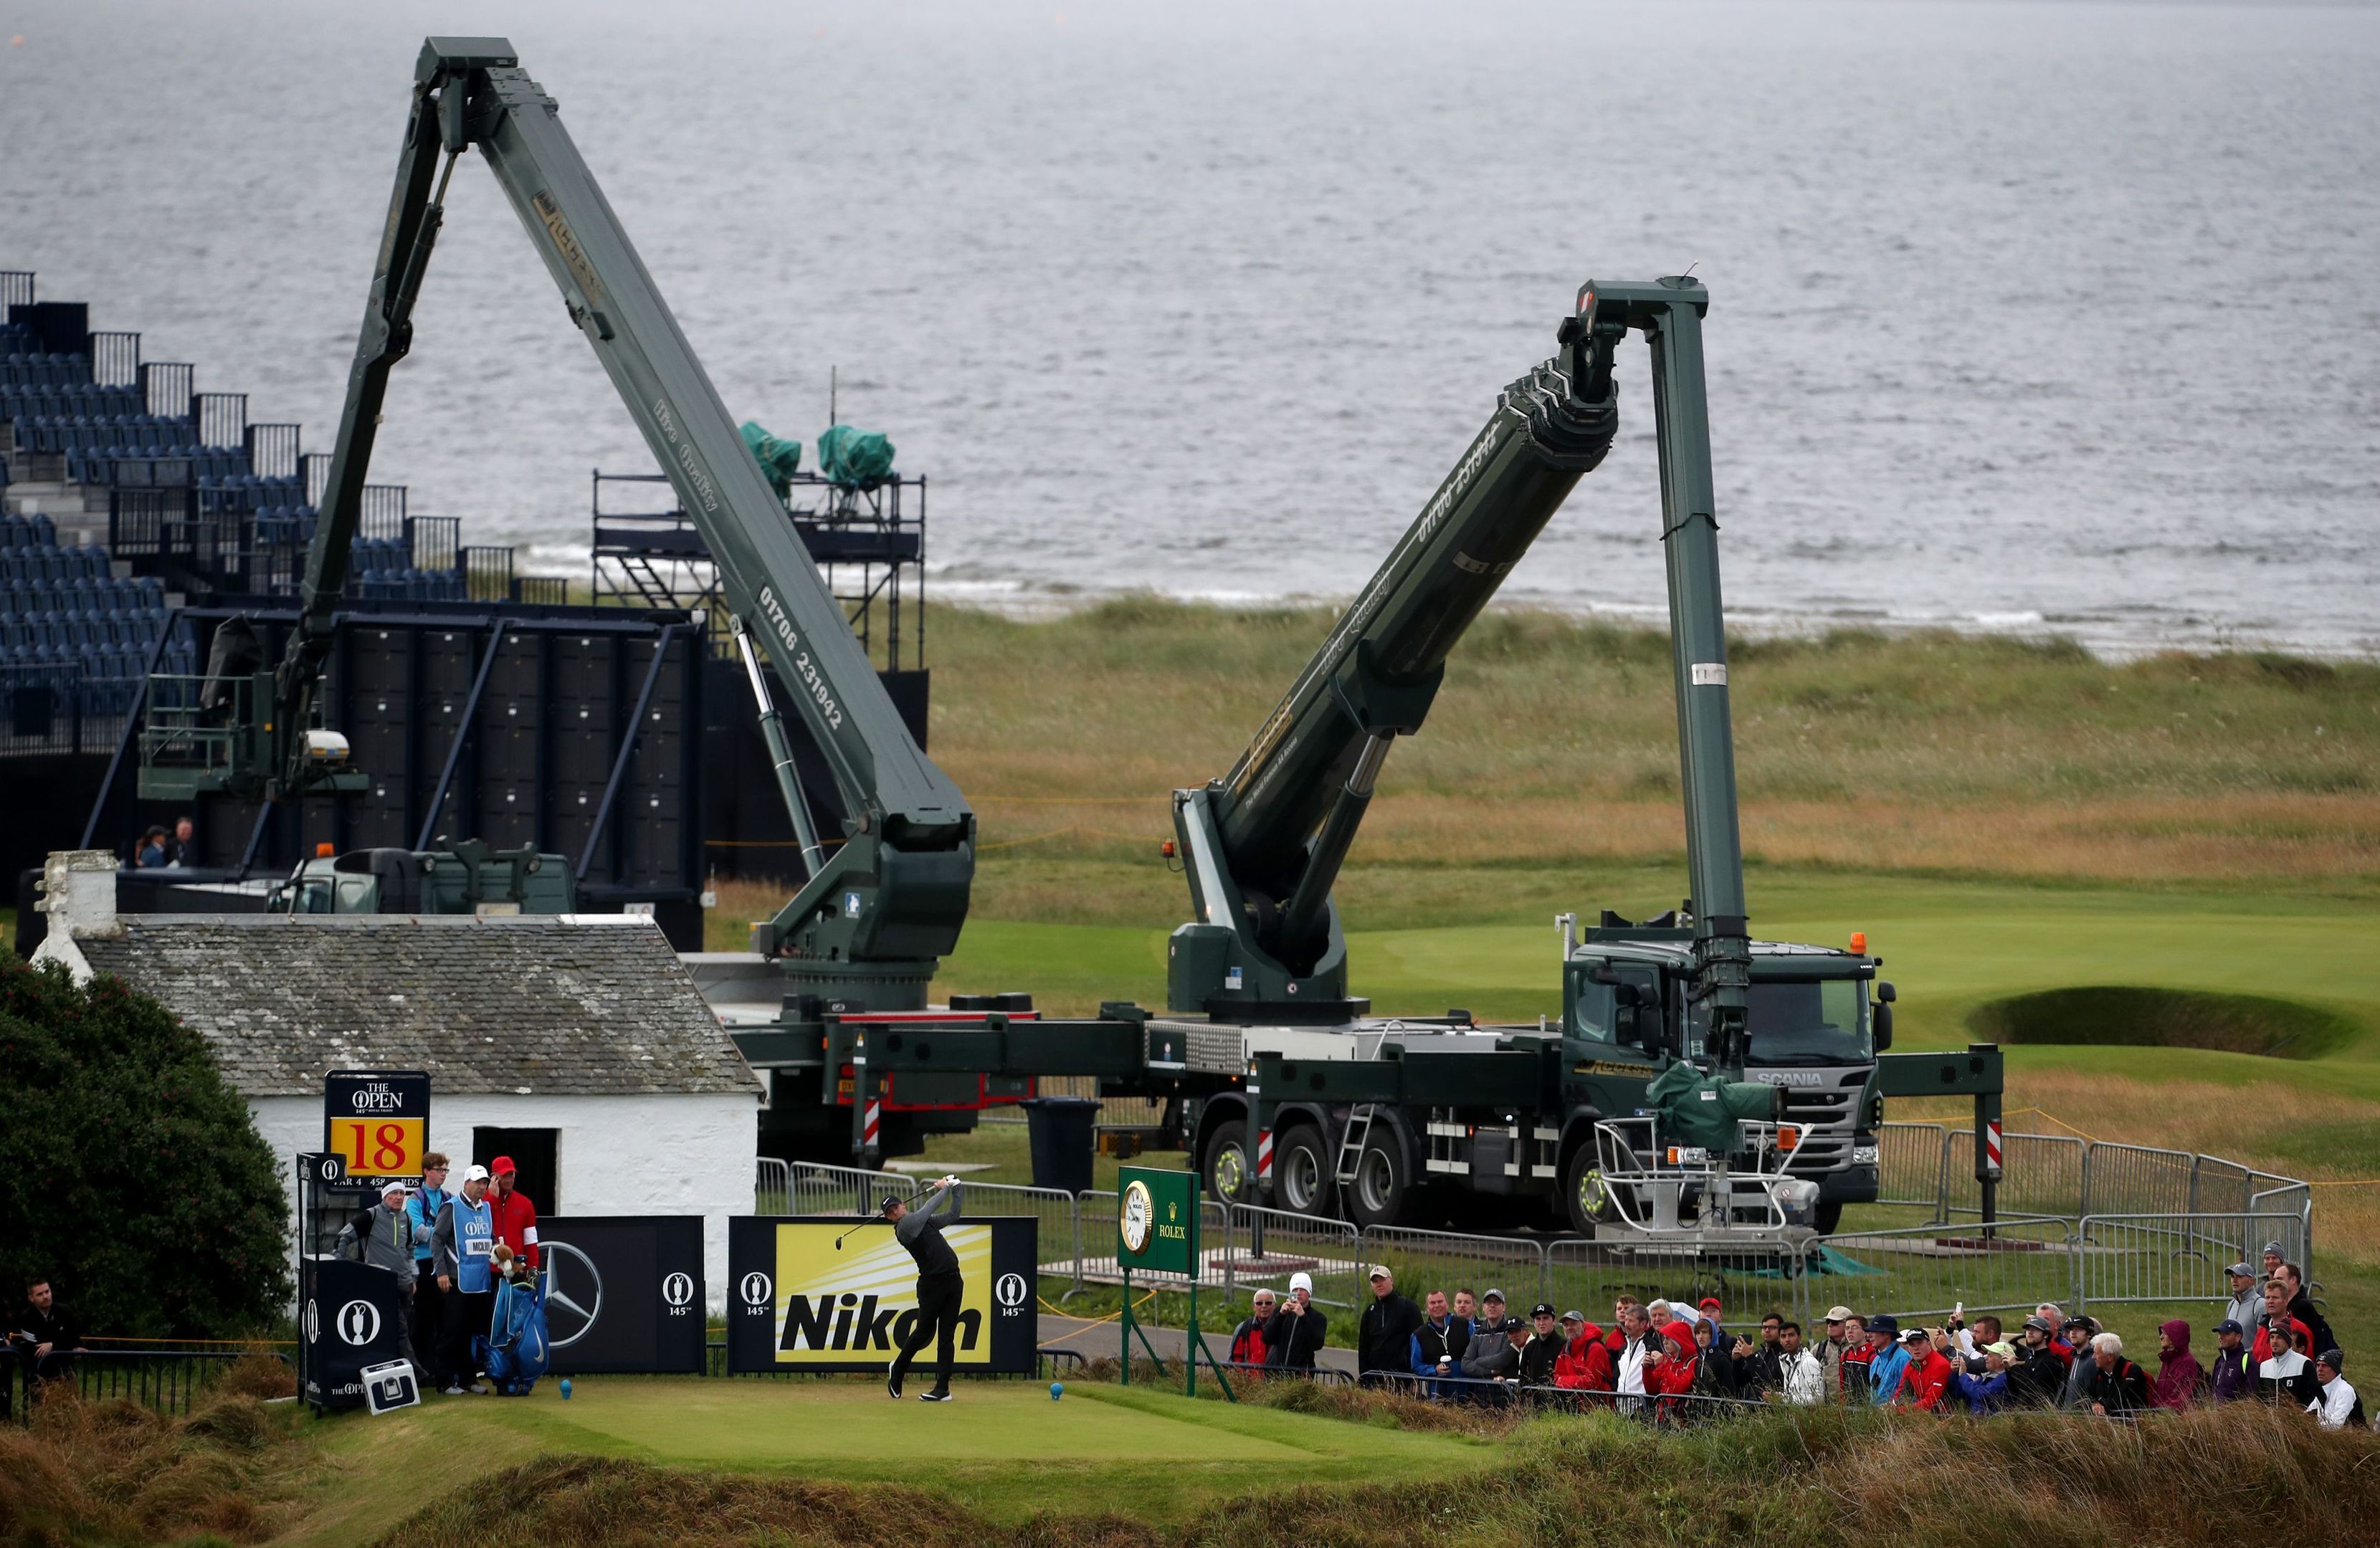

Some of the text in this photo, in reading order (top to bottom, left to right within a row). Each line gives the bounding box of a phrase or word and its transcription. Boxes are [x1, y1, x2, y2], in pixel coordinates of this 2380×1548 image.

[653, 398, 718, 512] Hire Quality
[760, 586, 842, 730] 01706 231942
[1758, 1072, 1824, 1086] SCANIA
[366, 1083, 389, 1092] THE
[352, 1090, 403, 1108] OPEN
[349, 1124, 406, 1170] 18
[355, 1177, 362, 1186] 4
[1159, 1224, 1186, 1239] ROLEX
[344, 1382, 364, 1395] OP
